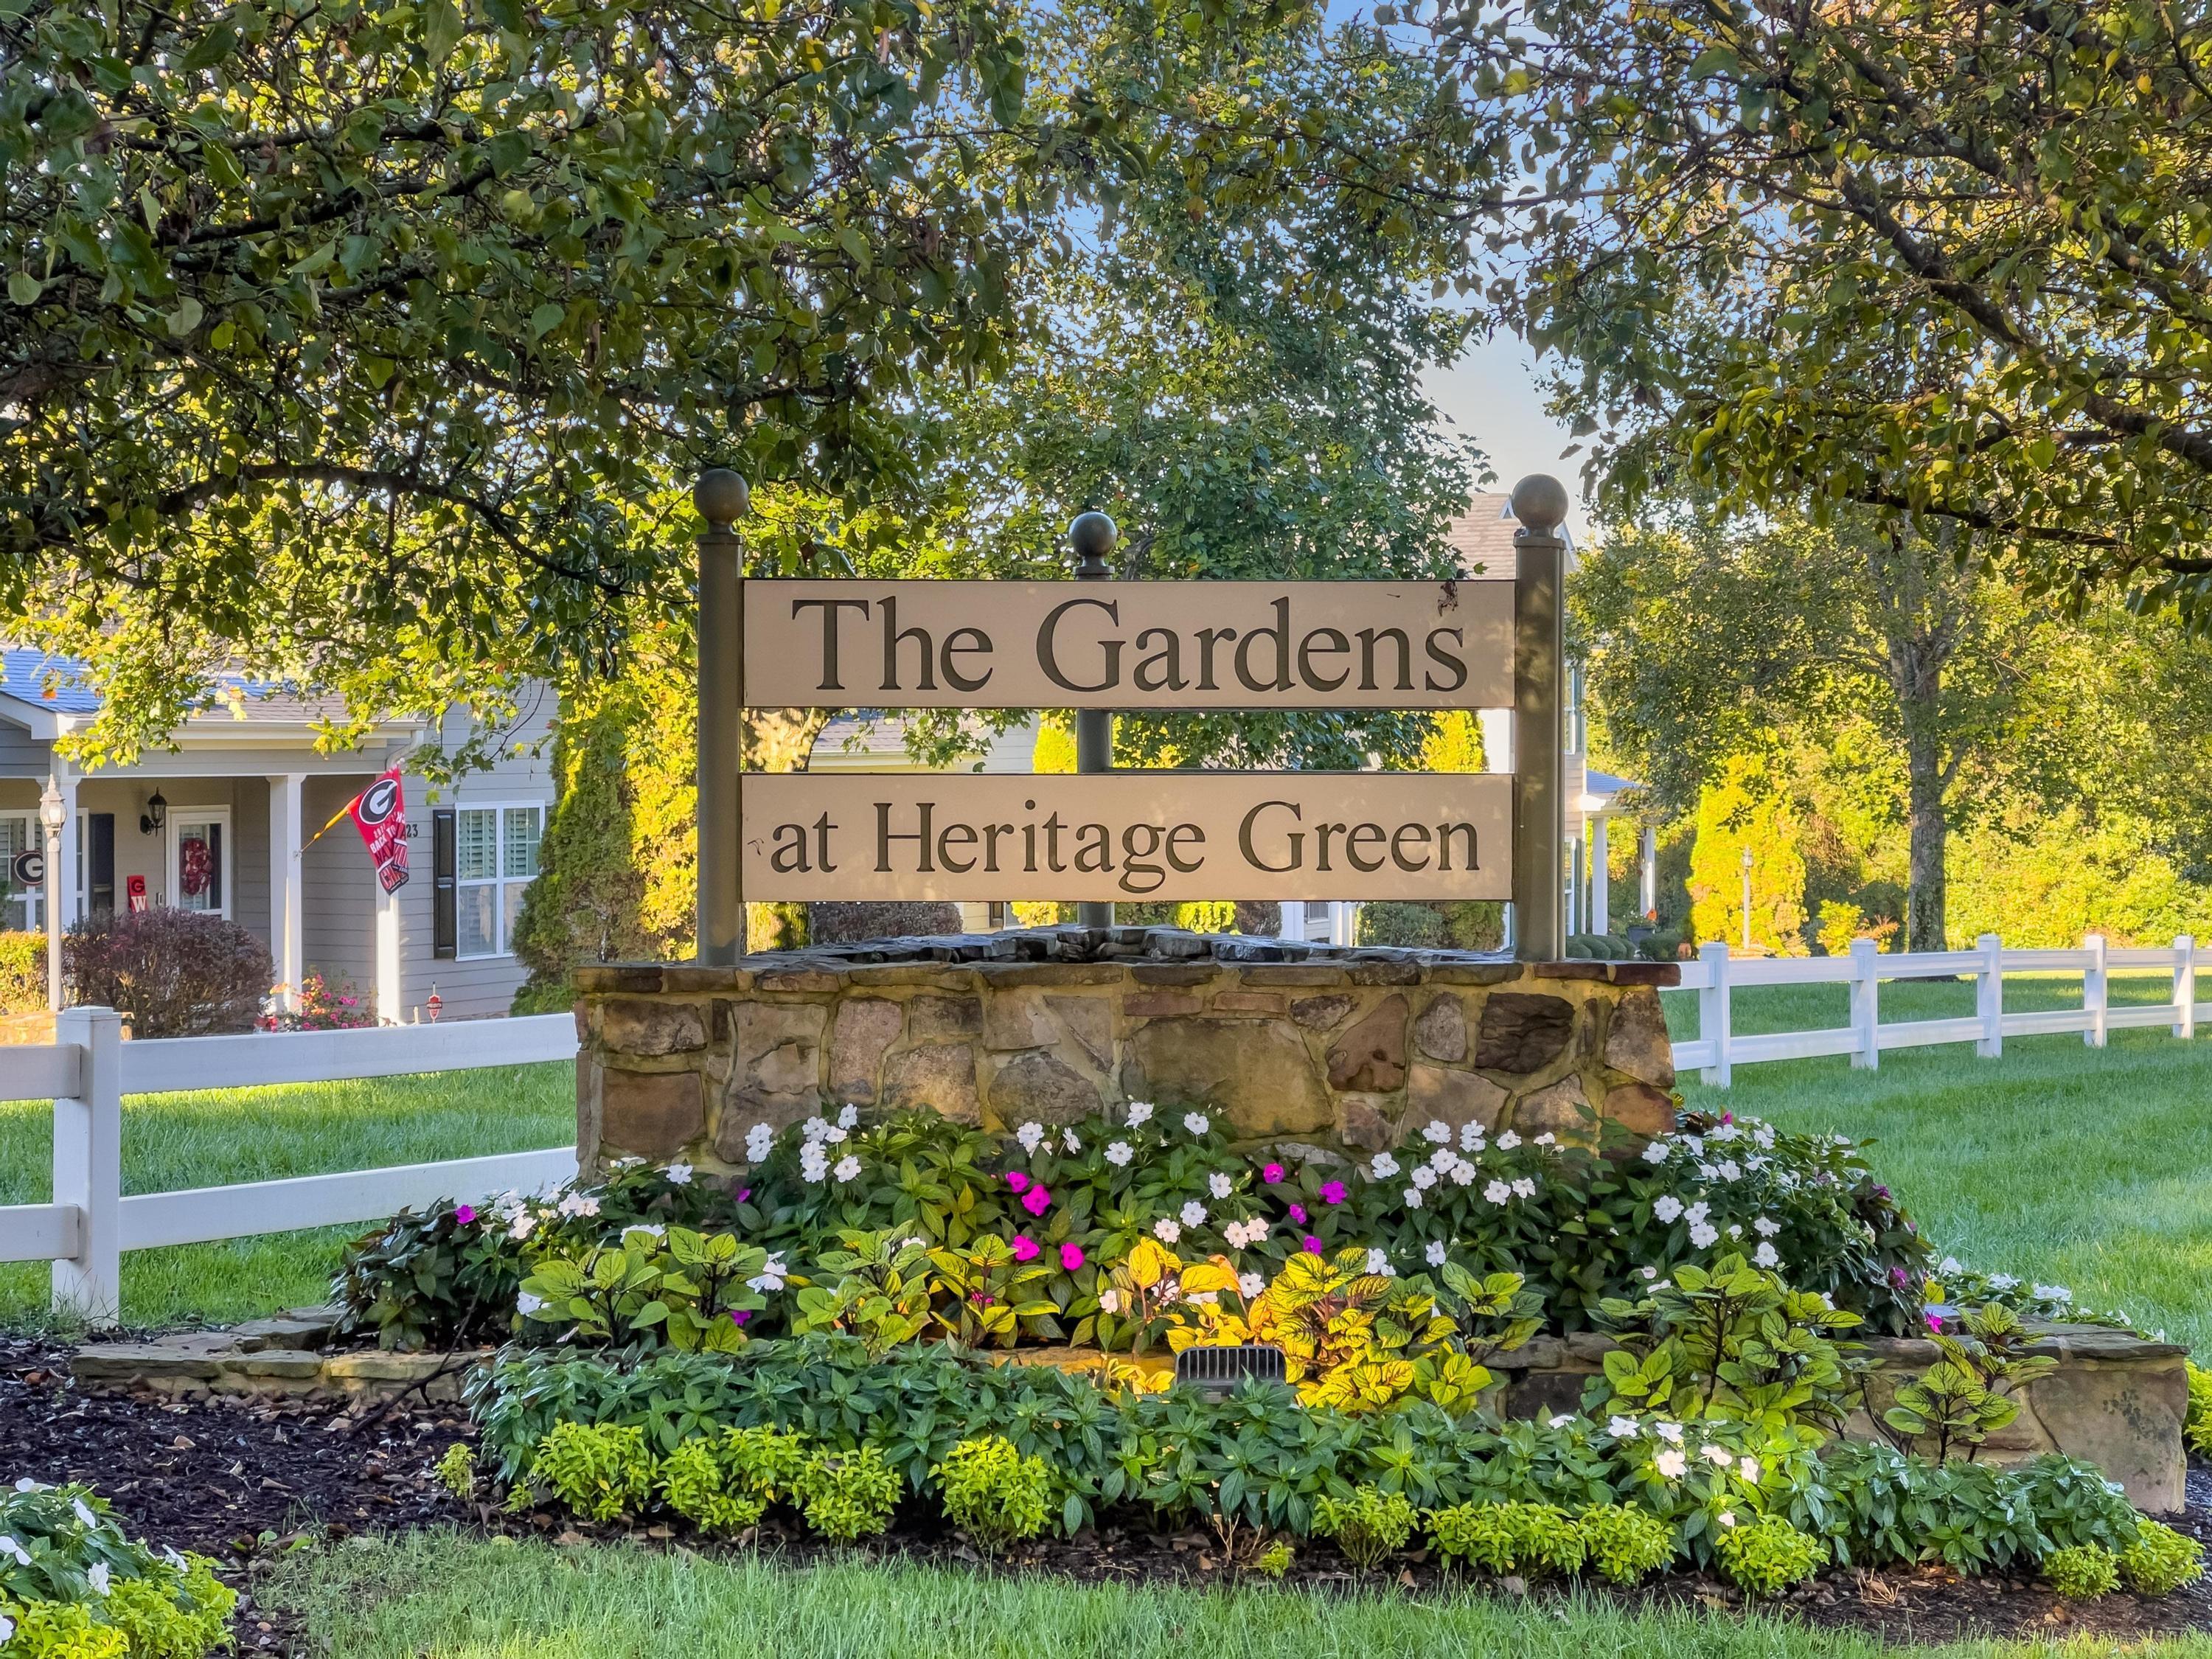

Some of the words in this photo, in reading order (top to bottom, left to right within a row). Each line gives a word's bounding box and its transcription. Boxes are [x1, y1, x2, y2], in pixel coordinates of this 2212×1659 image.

[792, 596, 994, 692] The
[1037, 596, 1468, 692] Gardens
[771, 811, 839, 873] at
[873, 800, 1206, 894] Heritage
[1239, 801, 1481, 873] Green
